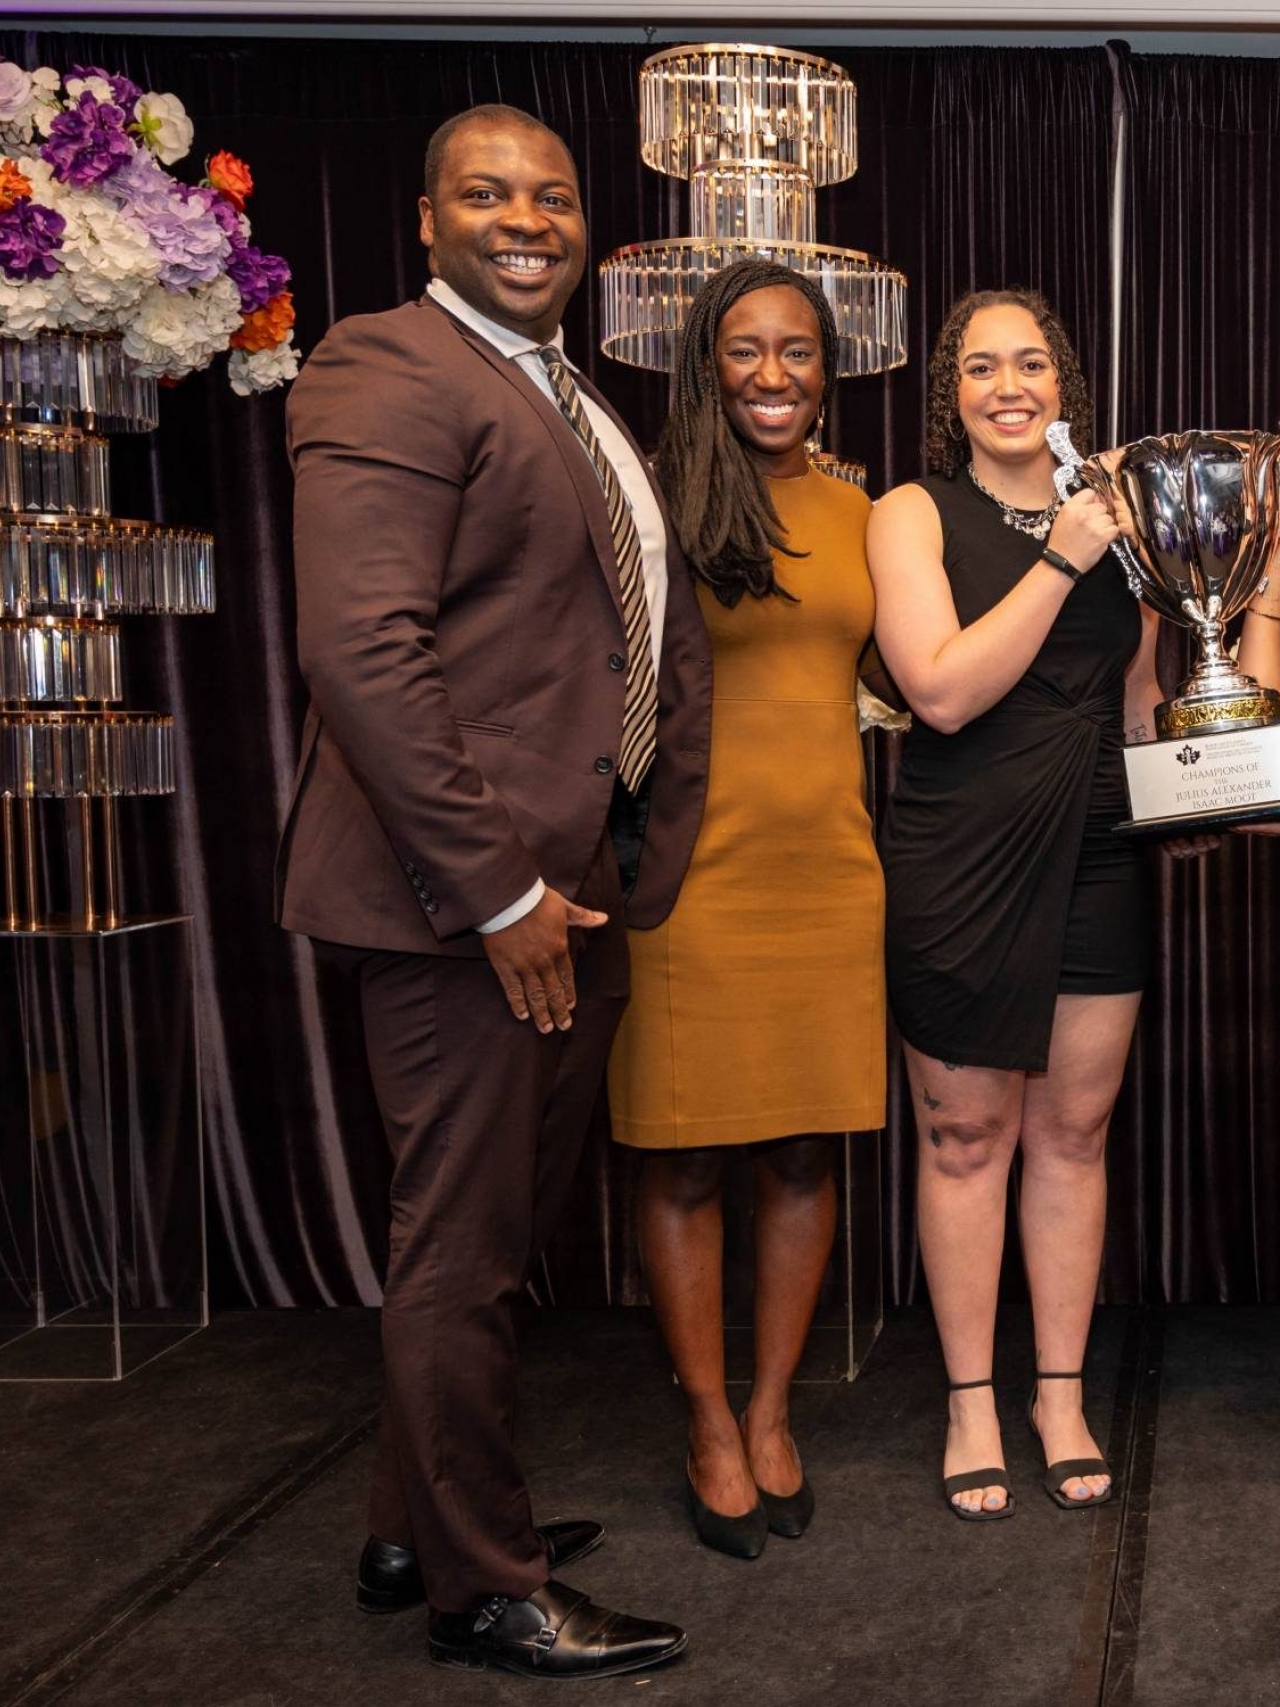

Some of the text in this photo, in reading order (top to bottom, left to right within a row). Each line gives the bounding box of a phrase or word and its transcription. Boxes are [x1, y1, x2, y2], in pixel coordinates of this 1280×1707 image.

[1181, 761, 1259, 781] CHAMPIONS OF
[1175, 779, 1272, 802] JULIUS ALEXANDER
[1192, 793, 1256, 810] ISAAC MOOT
